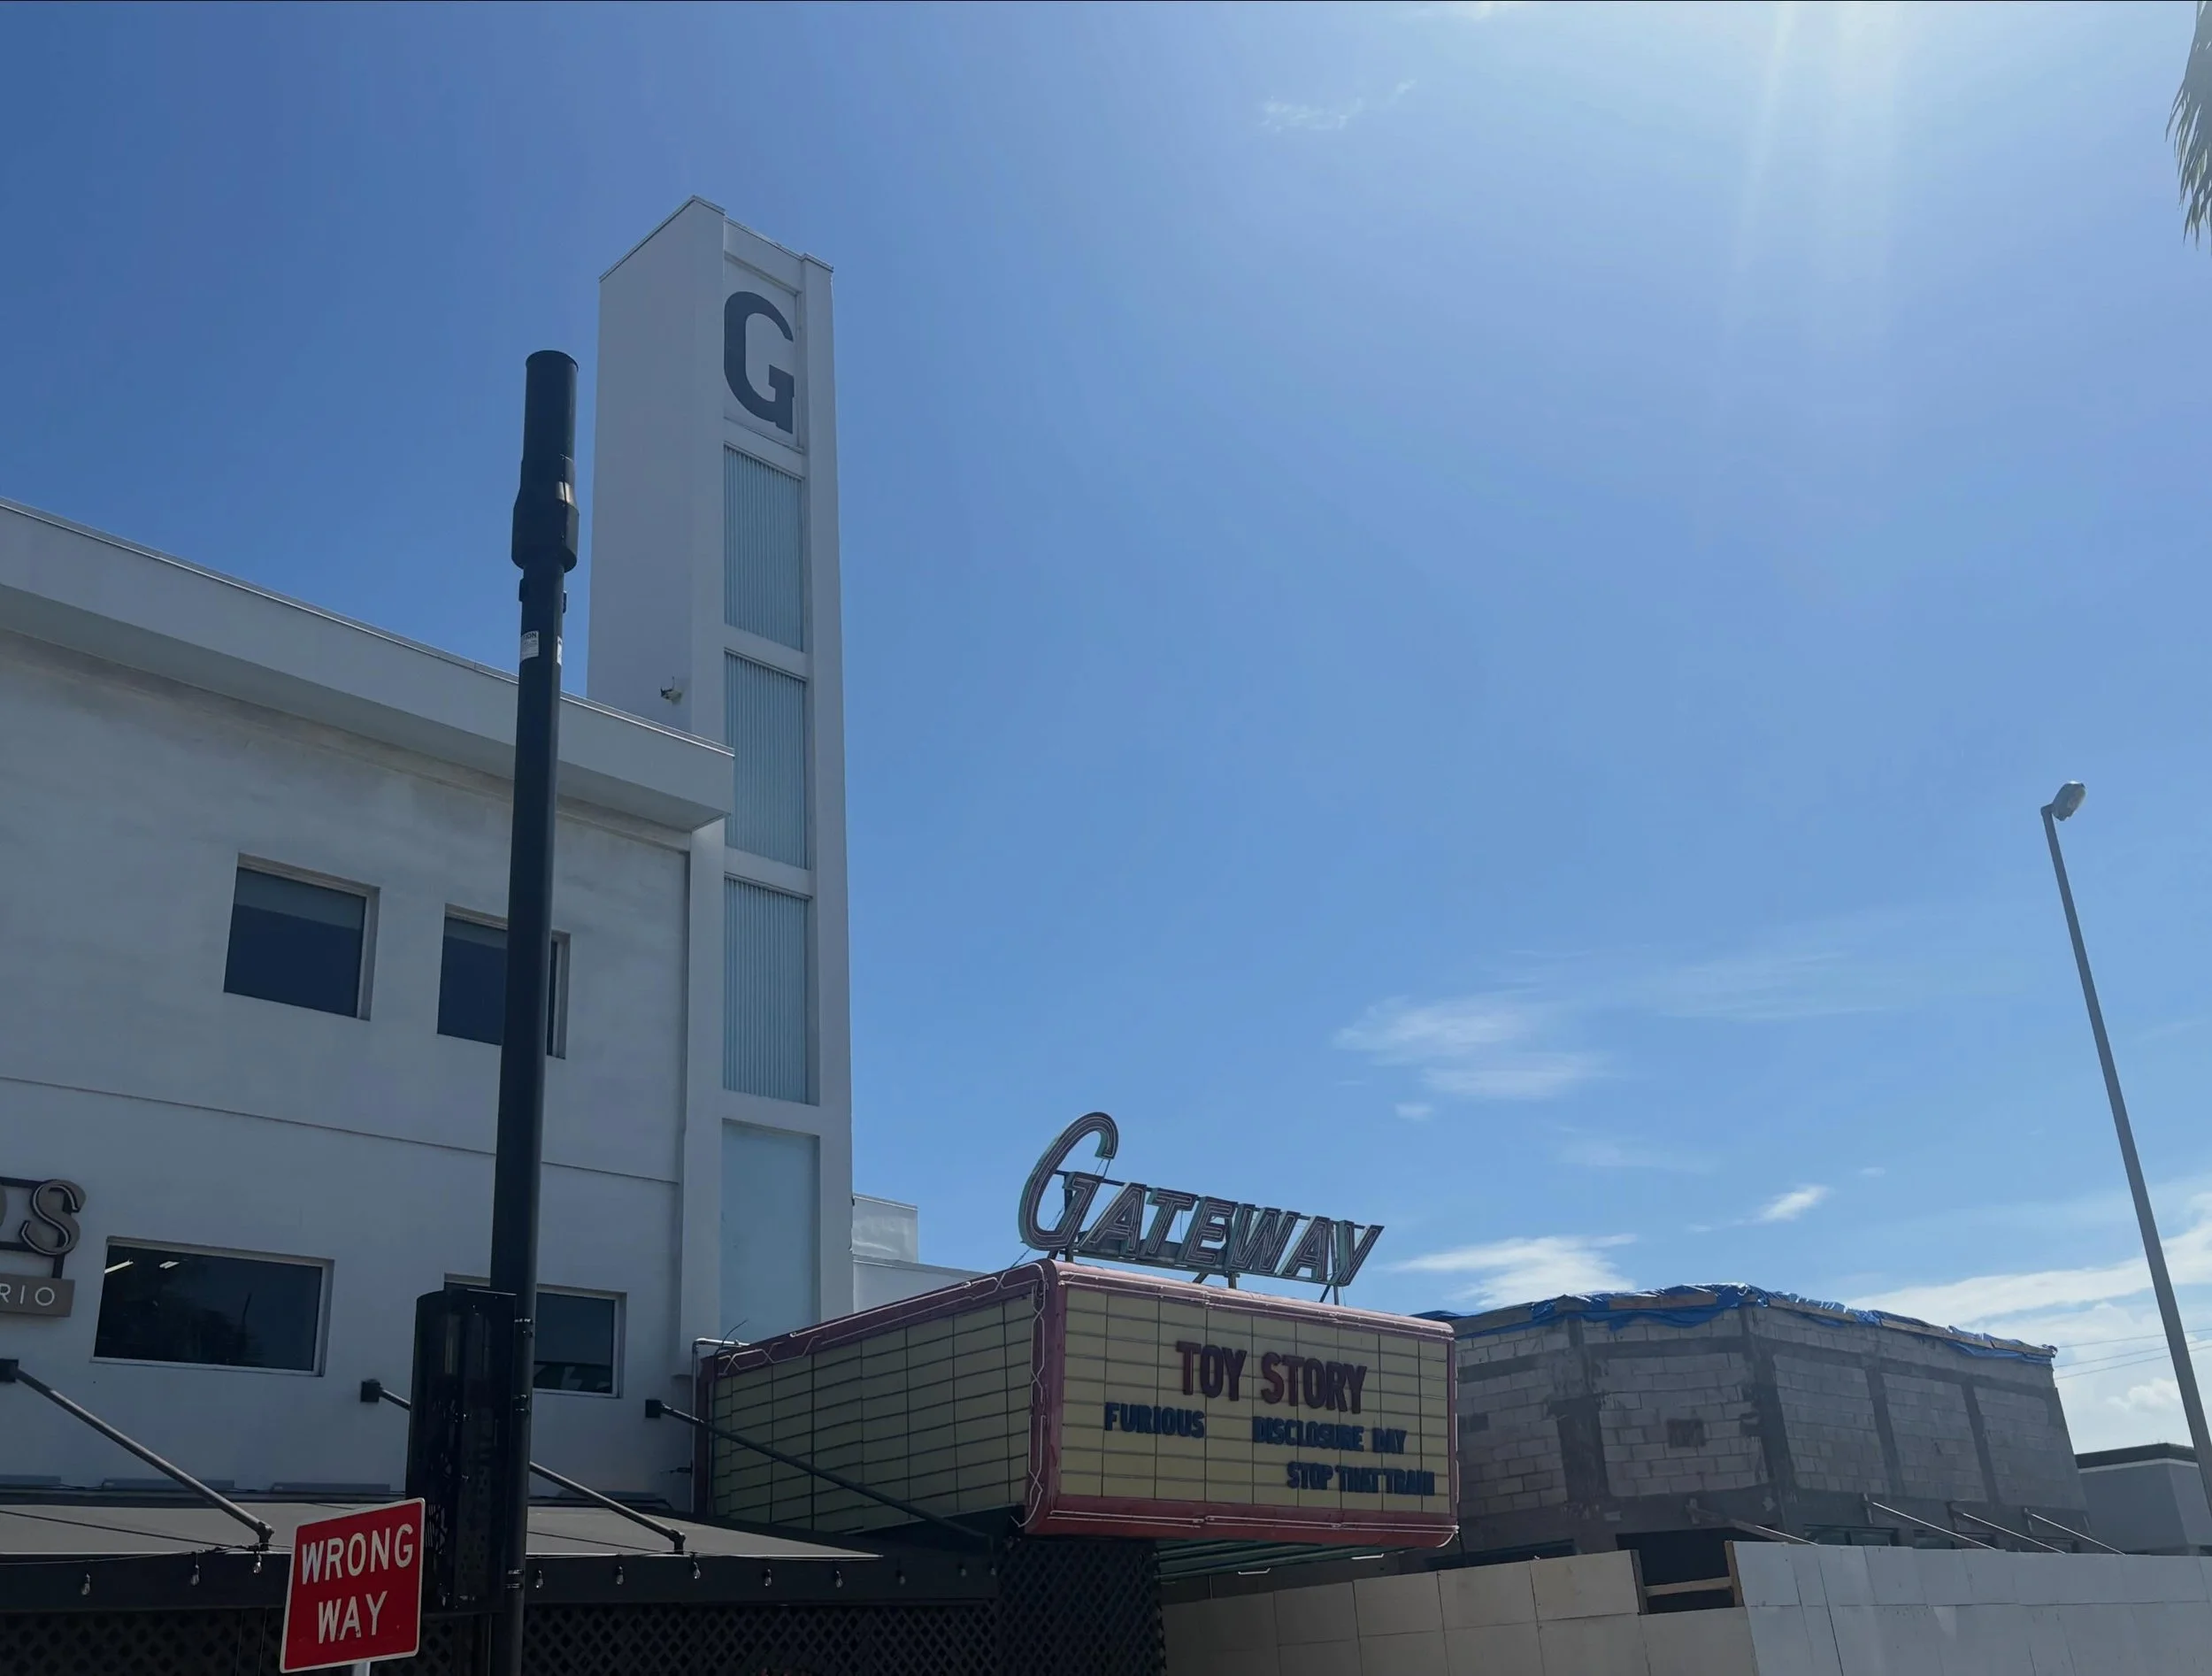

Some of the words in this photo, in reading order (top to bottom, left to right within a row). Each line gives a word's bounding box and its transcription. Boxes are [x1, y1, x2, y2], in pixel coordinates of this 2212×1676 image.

[724, 291, 795, 434] G
[0, 1178, 86, 1256] S
[1018, 1111, 1385, 1287] GATEWAY
[1176, 1341, 1247, 1401] TOY
[1261, 1351, 1368, 1414] STORY
[1104, 1402, 1205, 1438] FURIOUS
[1252, 1416, 1364, 1452] DISCLOSURE
[1372, 1427, 1408, 1455] DAY
[1286, 1461, 1334, 1490] STOP
[302, 1524, 413, 1585] WRONG
[318, 1591, 388, 1644] WAY
